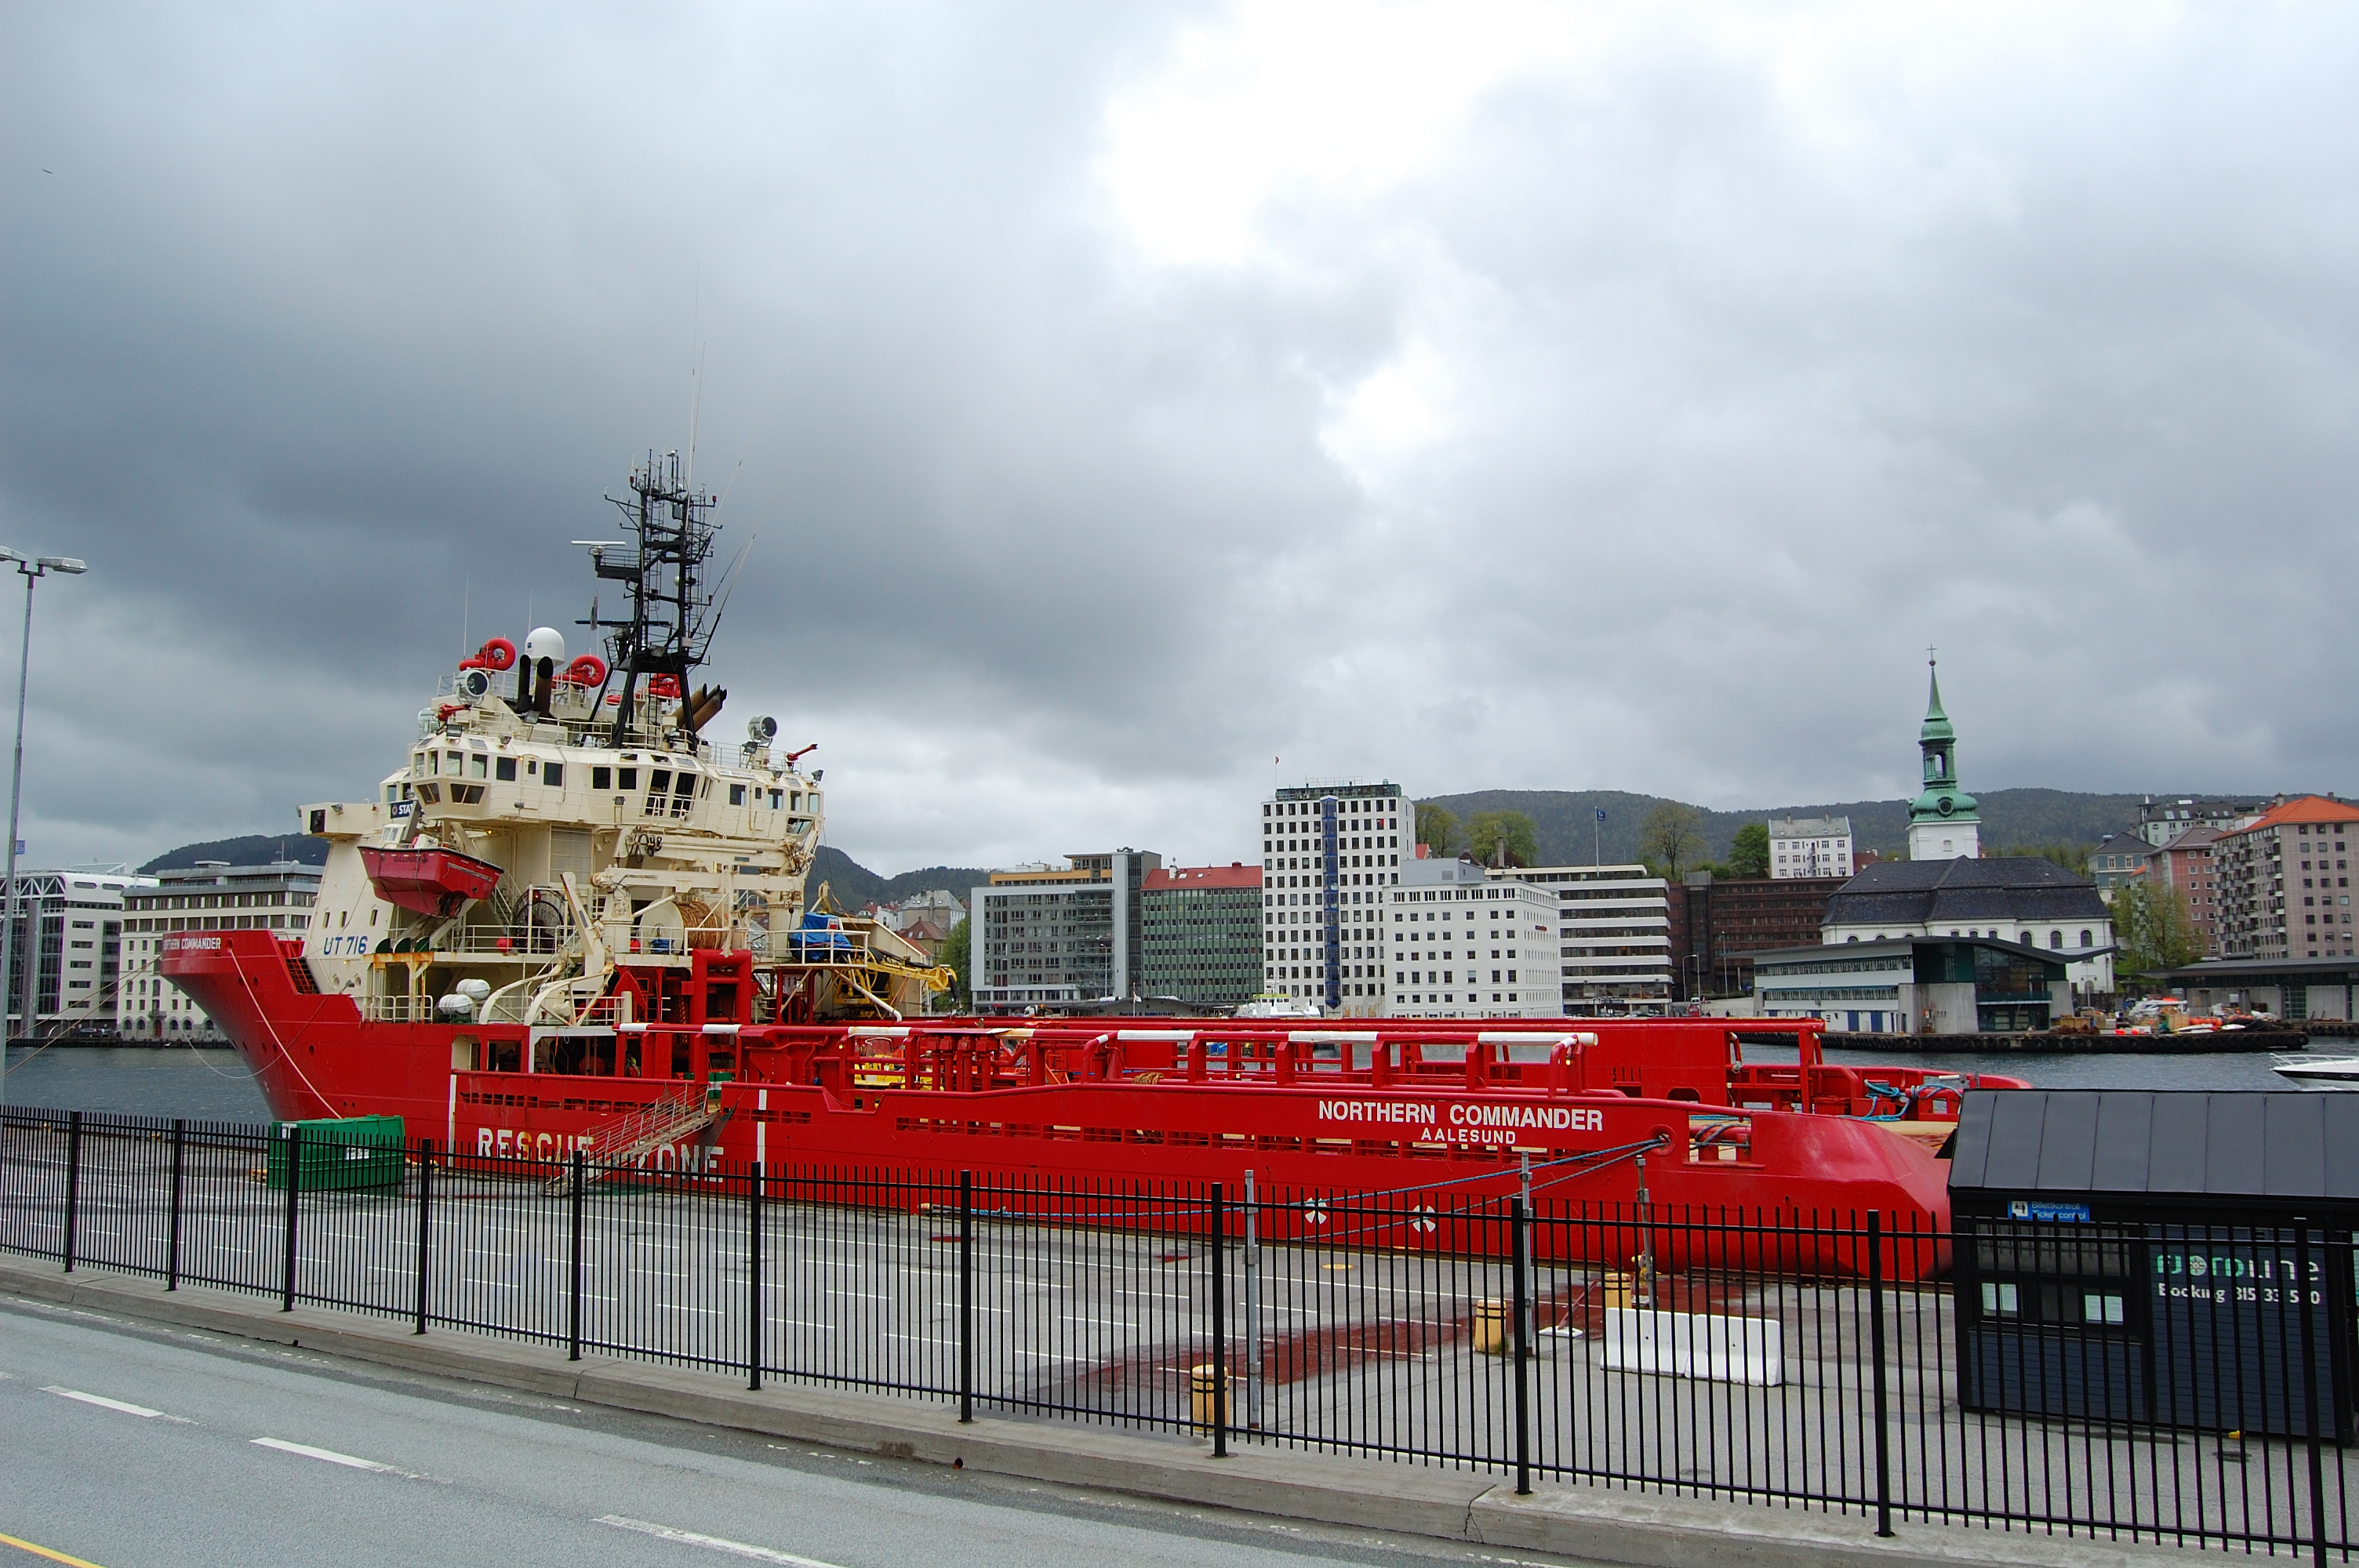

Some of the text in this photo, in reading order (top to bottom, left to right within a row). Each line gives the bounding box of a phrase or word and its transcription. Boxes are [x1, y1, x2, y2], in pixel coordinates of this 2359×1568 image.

[398, 804, 413, 815] STA
[181, 938, 221, 949] COMMANDER
[323, 935, 368, 955] UT 716
[1318, 1100, 1603, 1131] NORTHERN COMMANDER
[1420, 1127, 1516, 1145] AALESUND
[478, 1127, 594, 1167] RESCUE
[2058, 1211, 2086, 1220] control
[2234, 1286, 2257, 1301] 815
[2289, 1290, 2321, 1305] 50
